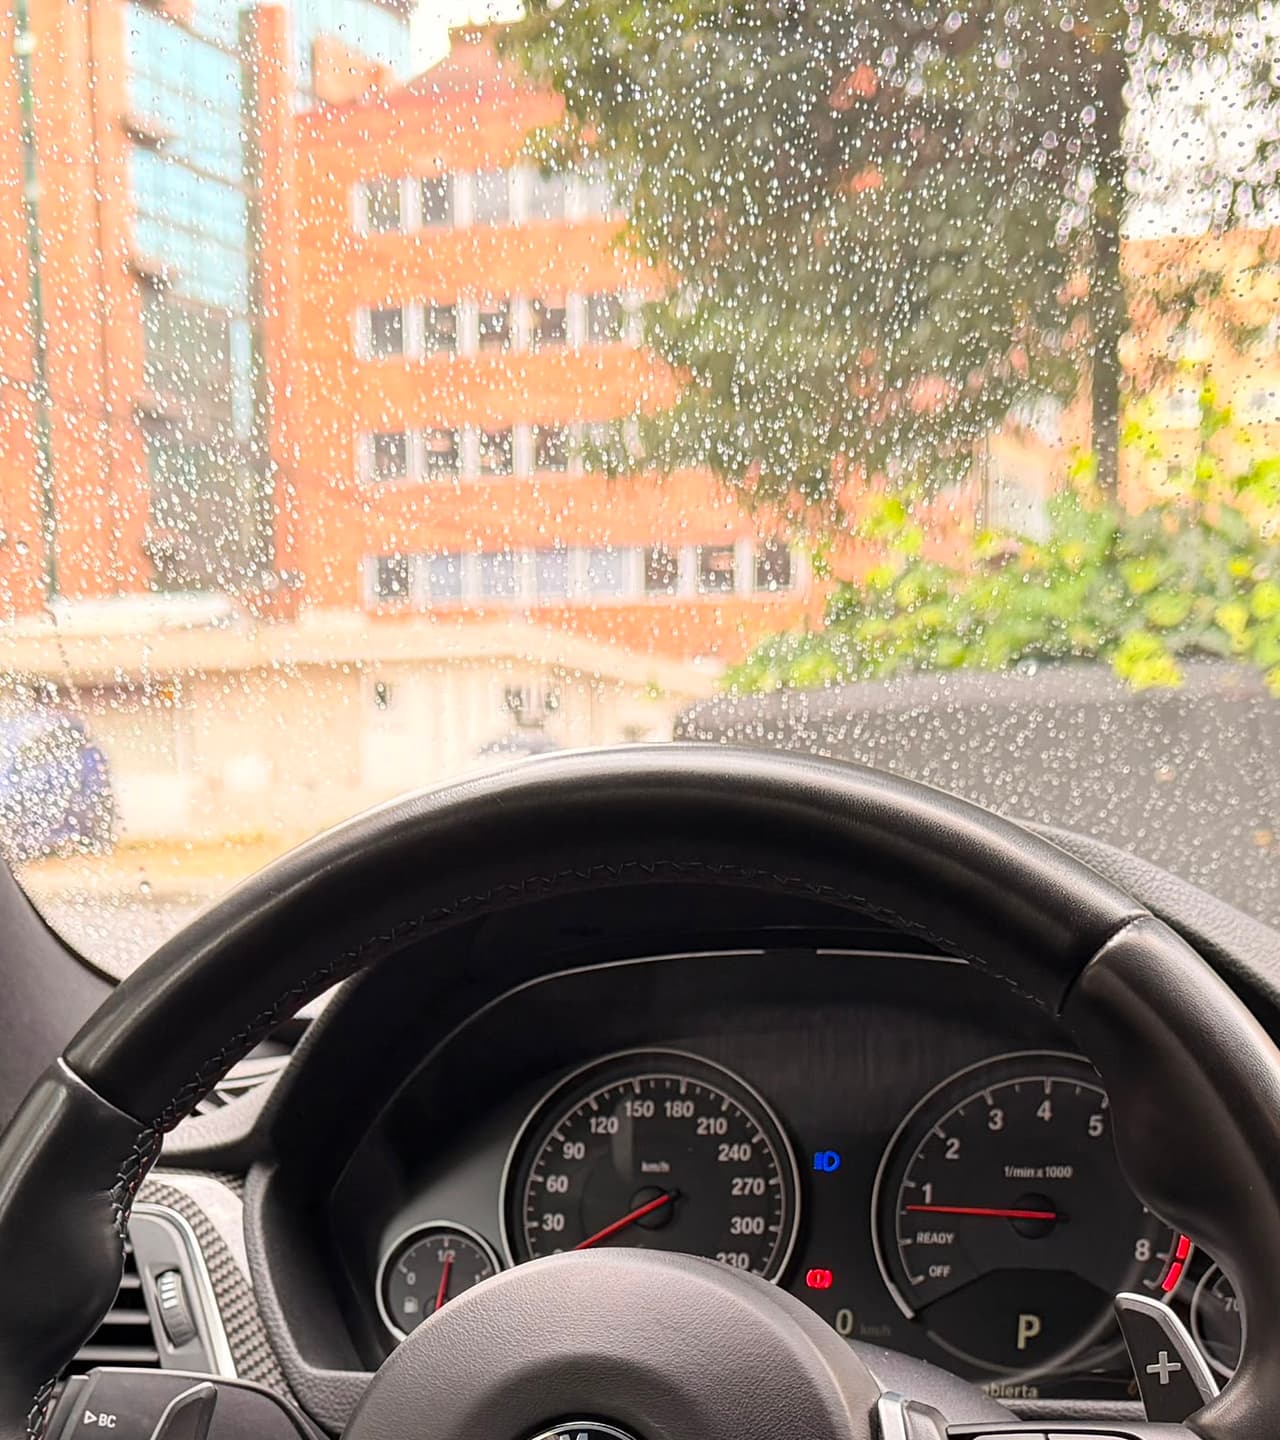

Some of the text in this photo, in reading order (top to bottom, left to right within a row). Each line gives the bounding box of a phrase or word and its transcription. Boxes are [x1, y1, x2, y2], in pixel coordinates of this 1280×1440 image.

[624, 1100, 654, 1118] 150
[664, 1100, 694, 1118] 180
[1036, 1100, 1052, 1121] 4
[589, 1116, 618, 1134] 120
[696, 1117, 728, 1135] 210
[988, 1109, 1004, 1131] 3
[1088, 1115, 1104, 1138] 5
[563, 1141, 585, 1160] 90
[718, 1143, 752, 1162] 240
[945, 1138, 960, 1160] 2
[1045, 1165, 1072, 1178] 1000
[546, 1175, 568, 1193] 60
[731, 1177, 765, 1196] 270
[922, 1183, 933, 1204] 1
[542, 1213, 565, 1232] 30
[730, 1217, 765, 1235] 300
[916, 1231, 955, 1245] READY
[1135, 1239, 1150, 1260] 8
[407, 1272, 416, 1286] 0
[929, 1265, 951, 1278] OFF
[835, 1309, 853, 1335] 0
[1016, 1313, 1041, 1350] P
[98, 1413, 117, 1428] BC
